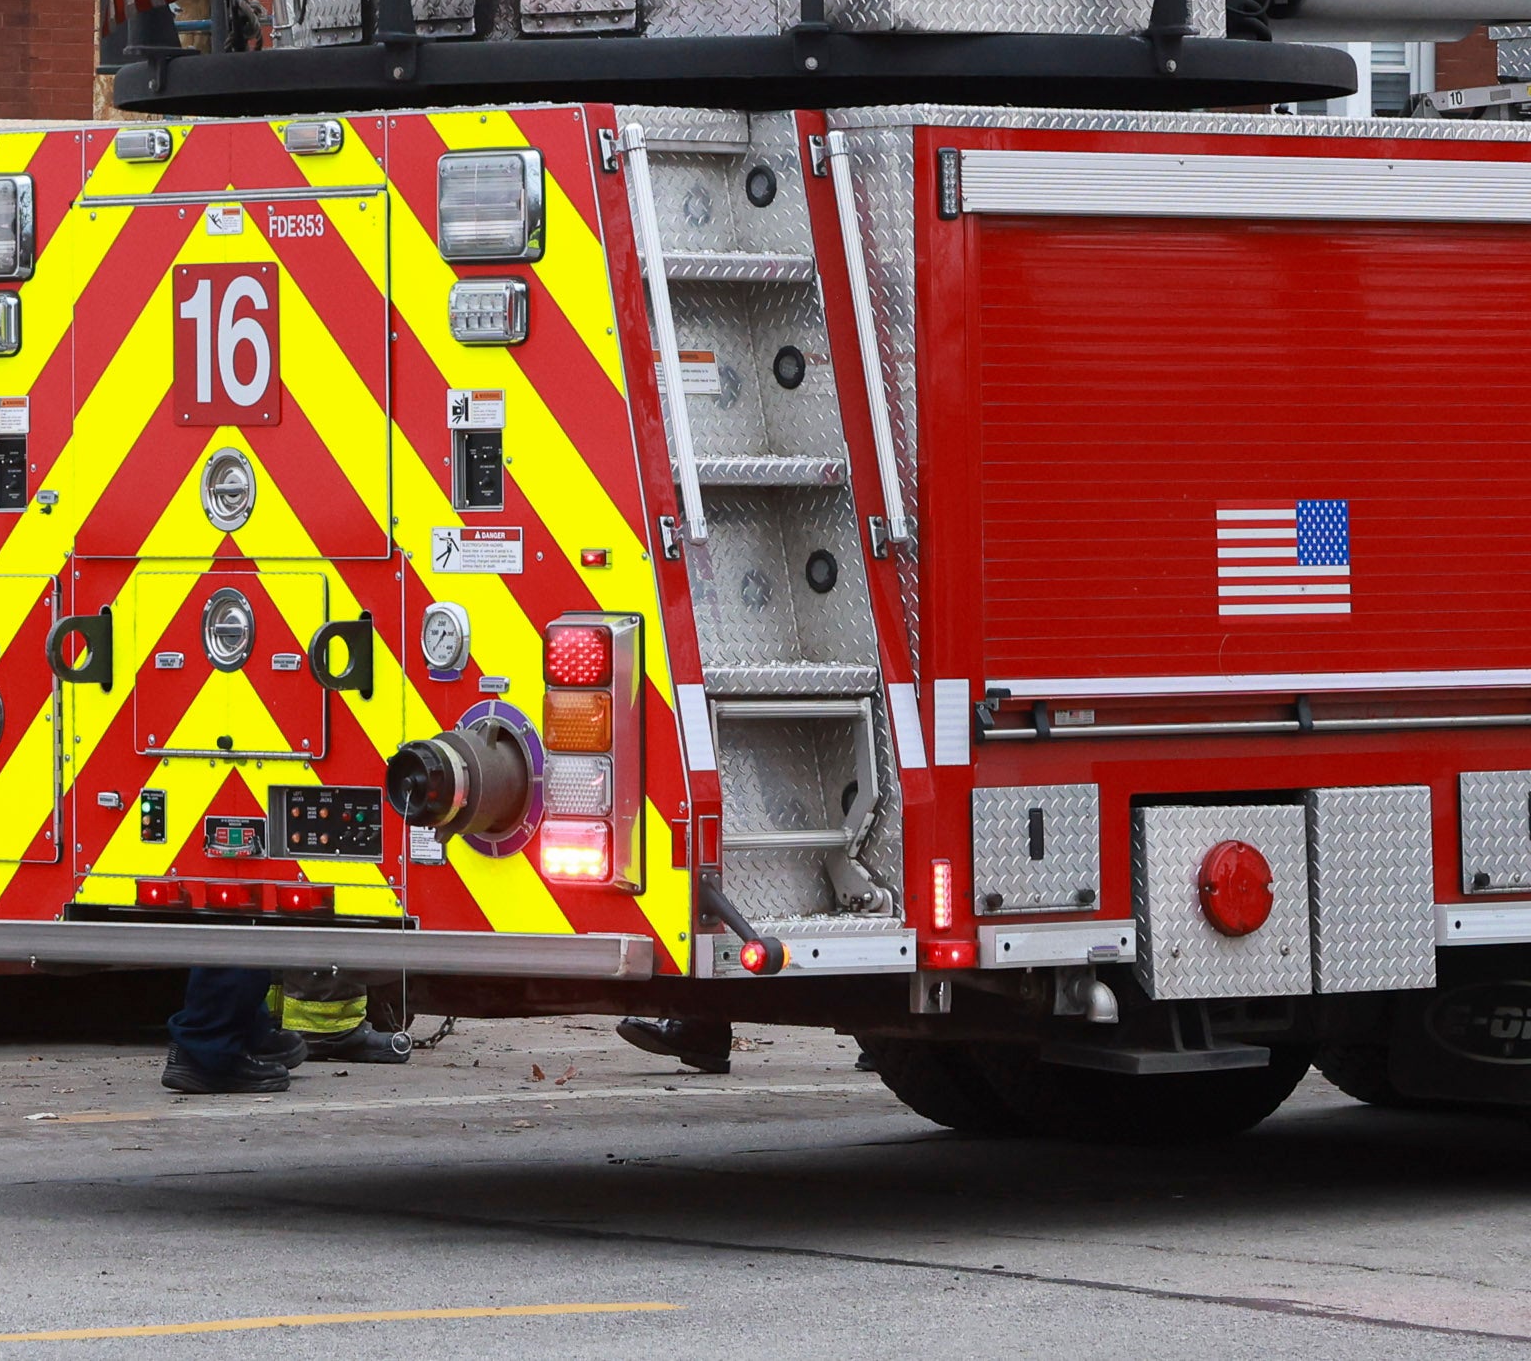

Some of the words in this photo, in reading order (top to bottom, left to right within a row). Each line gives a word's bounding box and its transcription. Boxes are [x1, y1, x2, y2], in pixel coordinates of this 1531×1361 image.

[1449, 90, 1463, 105] 10
[269, 214, 324, 238] FDE353
[180, 275, 271, 407] 16
[481, 531, 506, 539] DANGER
